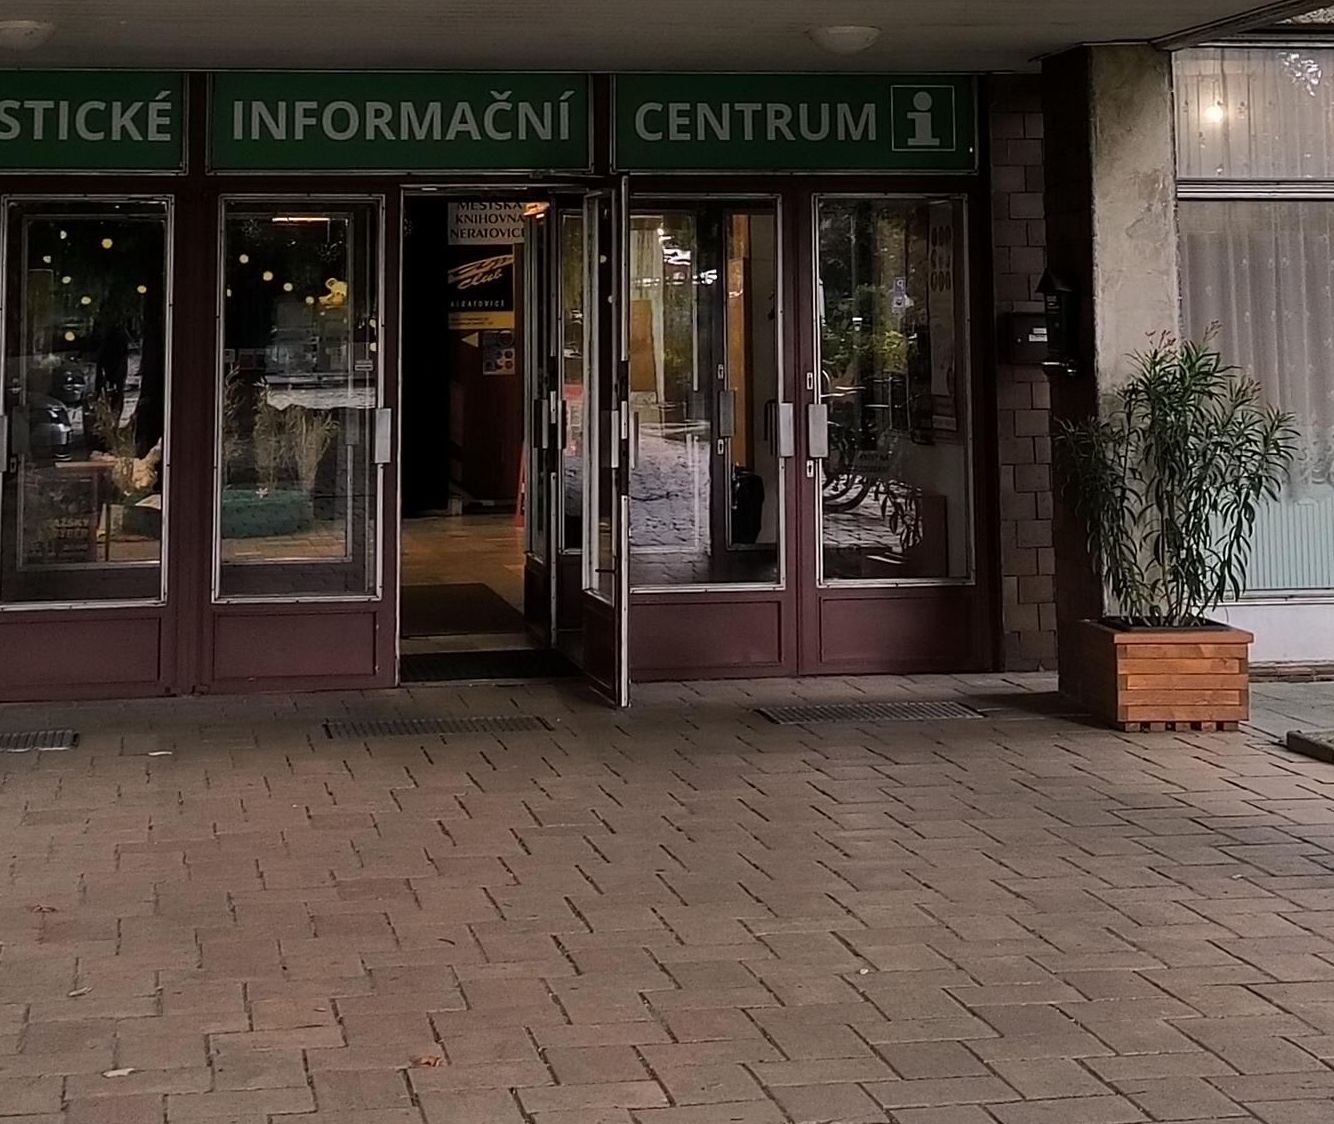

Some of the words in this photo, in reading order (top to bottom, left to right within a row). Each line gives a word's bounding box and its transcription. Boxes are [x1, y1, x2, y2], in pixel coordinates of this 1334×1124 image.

[231, 88, 577, 143] INFORMAČNÍ
[633, 100, 878, 144] CENTRUM
[455, 213, 526, 225] KNIHOVNA
